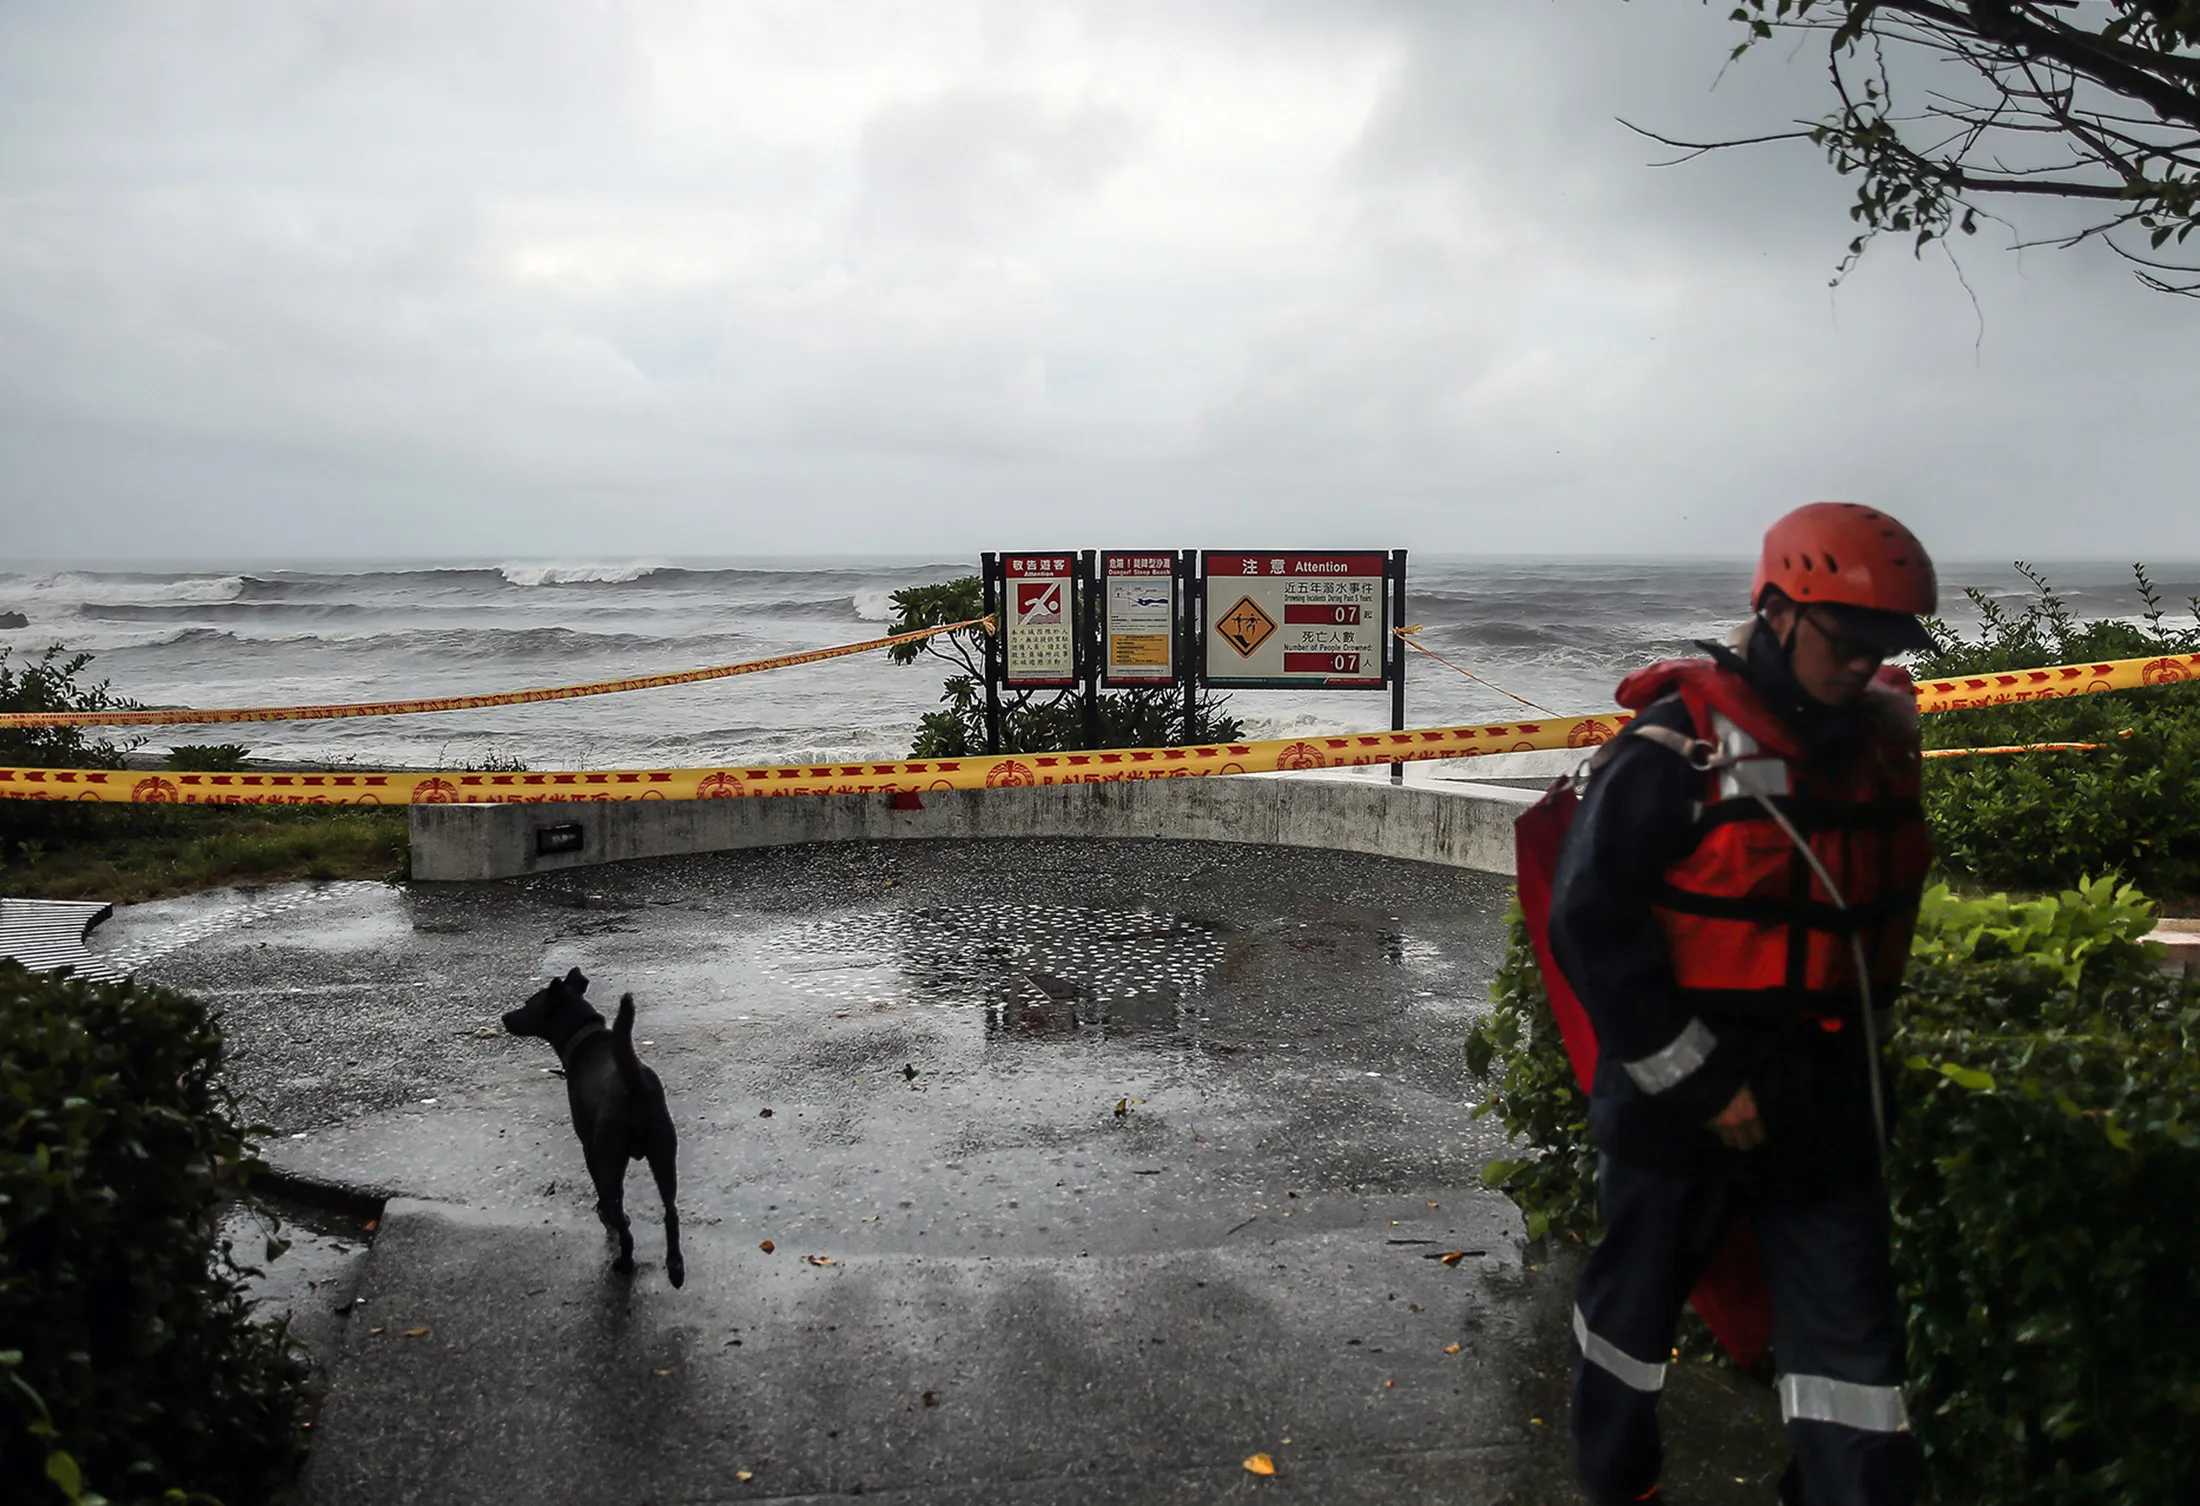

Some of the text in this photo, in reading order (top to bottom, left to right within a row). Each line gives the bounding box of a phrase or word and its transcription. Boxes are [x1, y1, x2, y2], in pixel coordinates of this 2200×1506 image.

[1242, 558, 1286, 575] 注意
[1295, 561, 1348, 573] Attention
[1284, 581, 1373, 594] 近五年溺水事件
[1284, 594, 1305, 603] Drowning
[1306, 594, 1326, 602] Incidents
[1327, 594, 1342, 603] During
[1343, 594, 1354, 602] Past
[1334, 606, 1373, 622] 07 起
[1302, 631, 1355, 643] 死亡人數
[1284, 643, 1373, 653] Number of People Drowned:
[1334, 654, 1372, 671] 07 人
